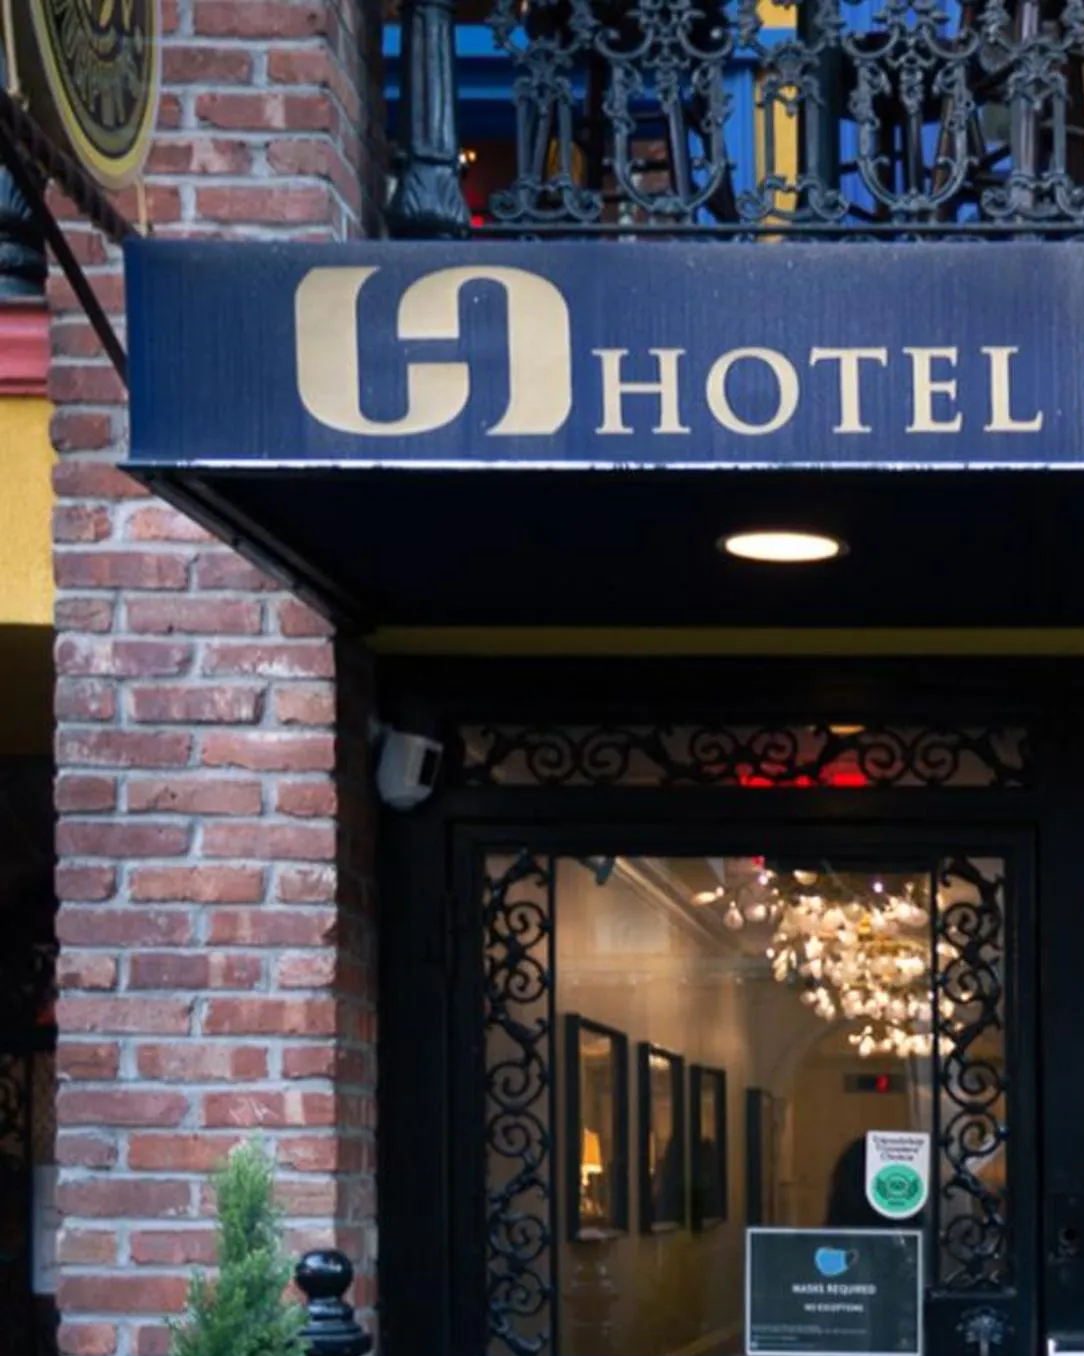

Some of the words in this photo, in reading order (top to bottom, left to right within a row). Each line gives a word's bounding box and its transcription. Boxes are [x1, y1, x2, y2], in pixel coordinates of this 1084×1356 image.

[592, 346, 1044, 434] HOTEL
[792, 1282, 824, 1295] MASKS
[826, 1282, 877, 1296] REQUIRED
